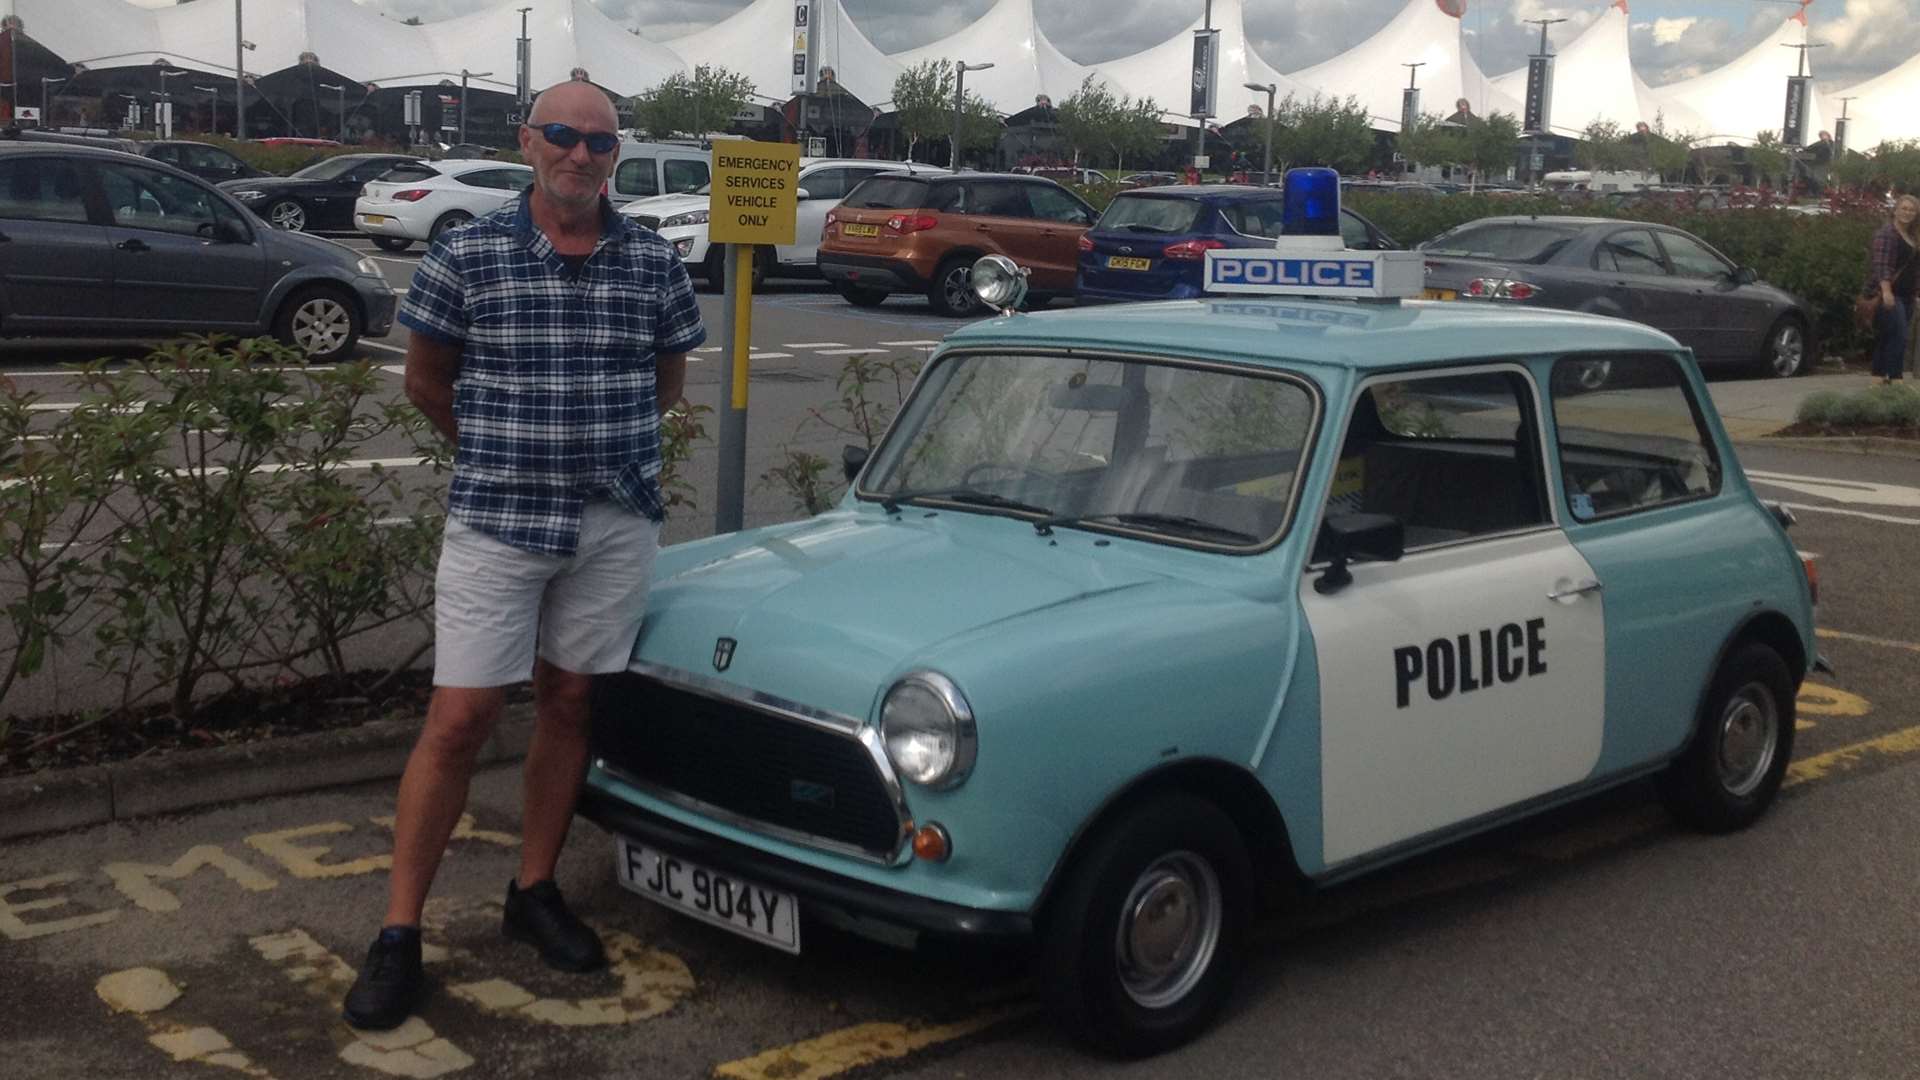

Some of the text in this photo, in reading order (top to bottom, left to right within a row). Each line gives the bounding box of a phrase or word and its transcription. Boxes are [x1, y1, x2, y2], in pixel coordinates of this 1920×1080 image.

[718, 156, 794, 171] EMERGENCY
[726, 176, 785, 190] SERVICES
[727, 195, 777, 208] VEHICLE
[738, 214, 769, 226] ONLY
[1216, 260, 1372, 286] POLICE
[1394, 617, 1548, 709] POLICE
[625, 844, 779, 935] FJC 904Y
